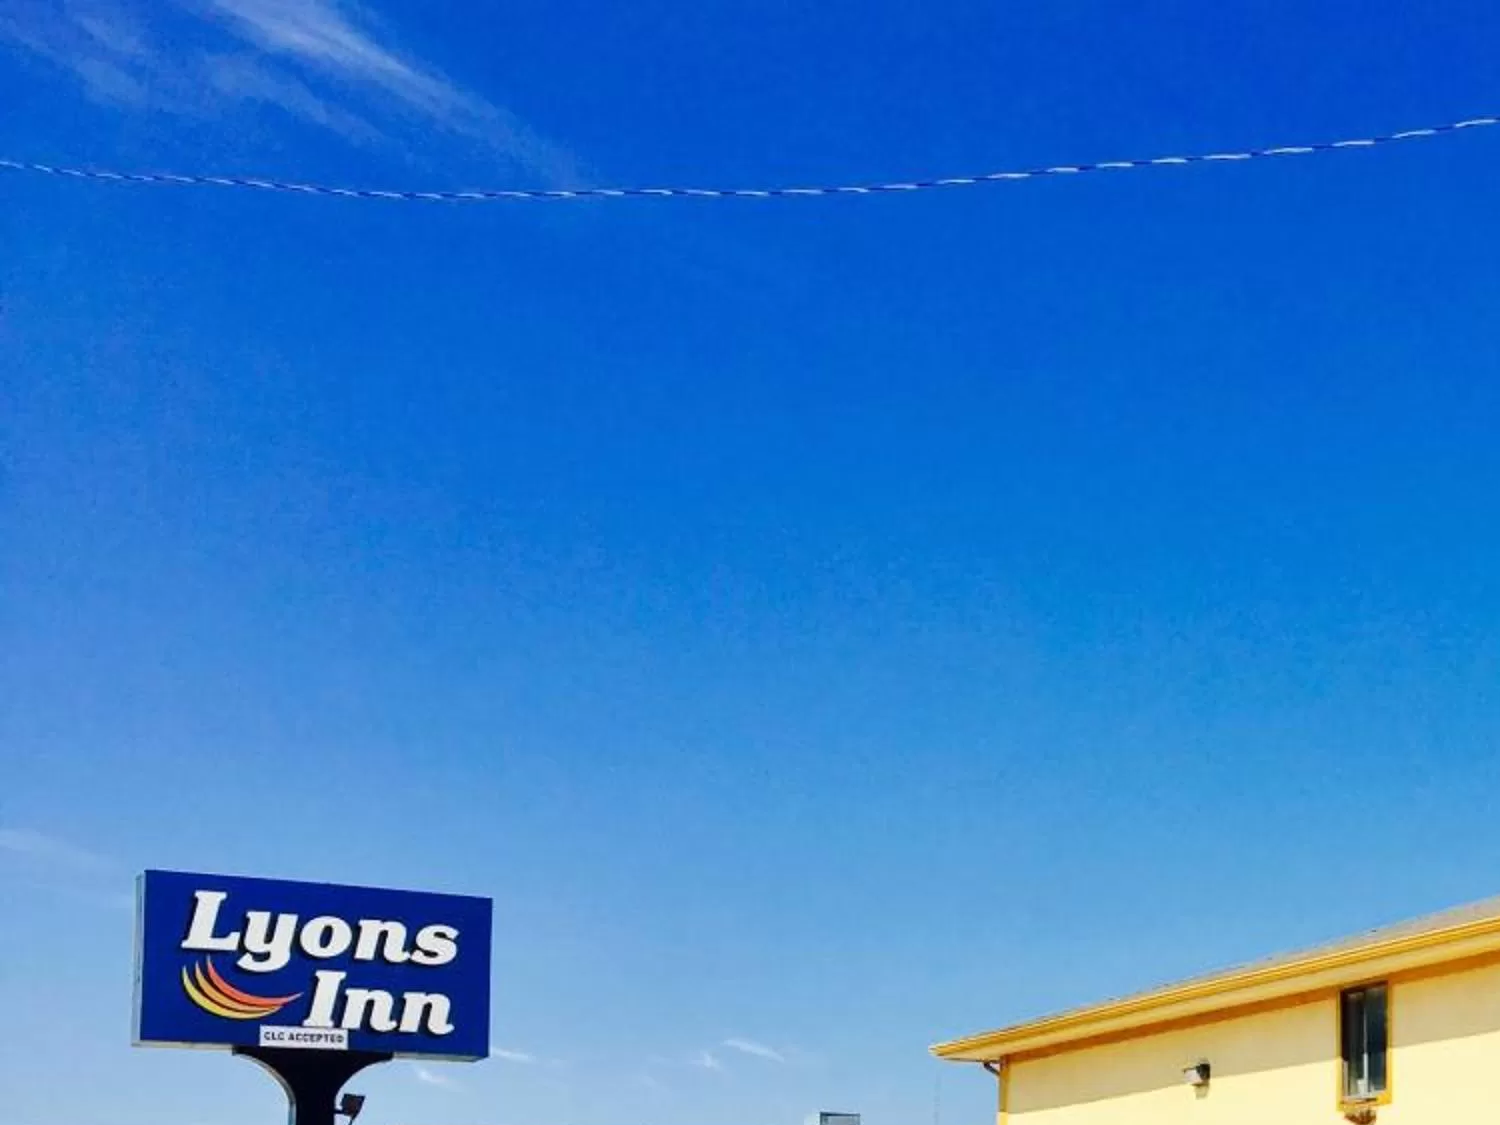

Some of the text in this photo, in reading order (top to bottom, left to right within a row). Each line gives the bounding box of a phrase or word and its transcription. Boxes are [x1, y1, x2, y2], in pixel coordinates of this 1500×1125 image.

[181, 889, 460, 972] Lyons
[302, 970, 455, 1035] Inn
[263, 1031, 345, 1044] CLC ACCEPTED
